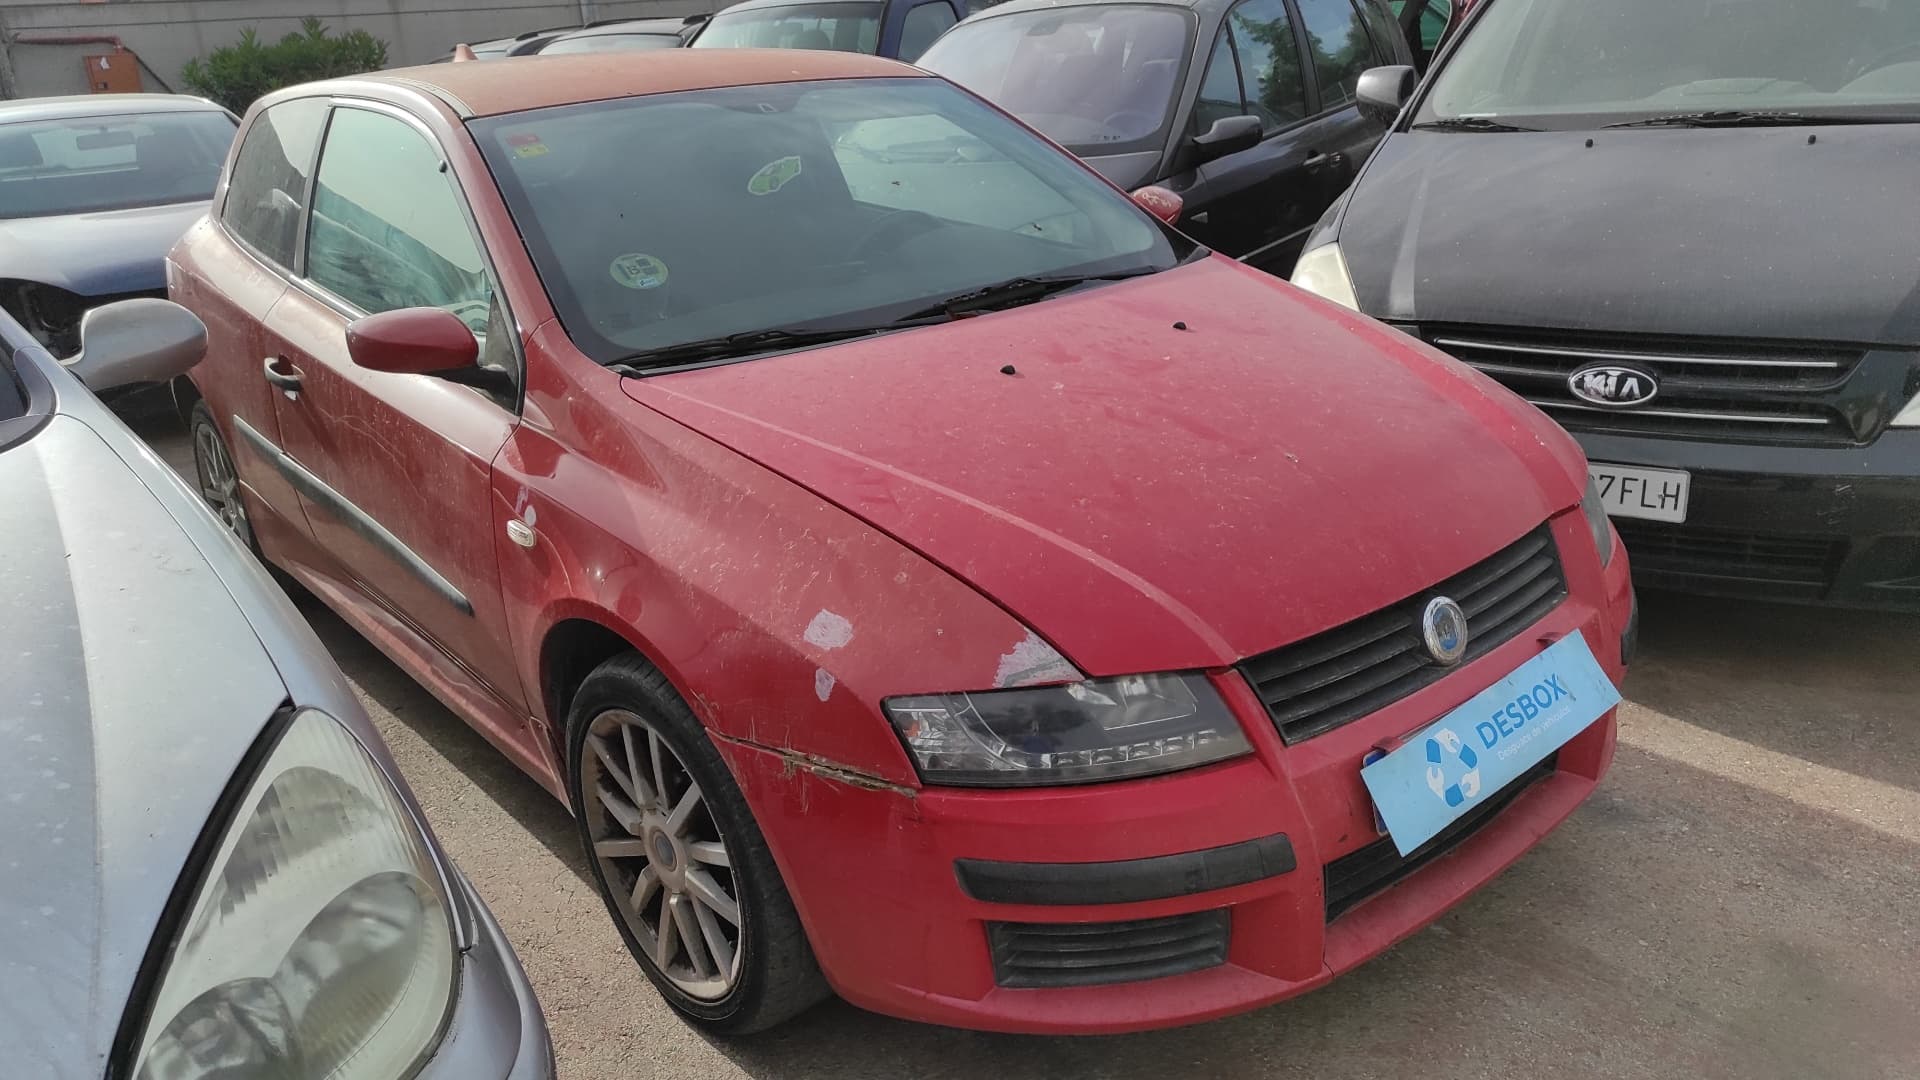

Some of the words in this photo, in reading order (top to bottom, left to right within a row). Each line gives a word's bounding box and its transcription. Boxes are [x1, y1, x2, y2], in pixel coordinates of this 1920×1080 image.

[1583, 373, 1641, 399] KIA
[1592, 474, 1681, 511] 7FLH
[1475, 673, 1568, 750] DESBOX
